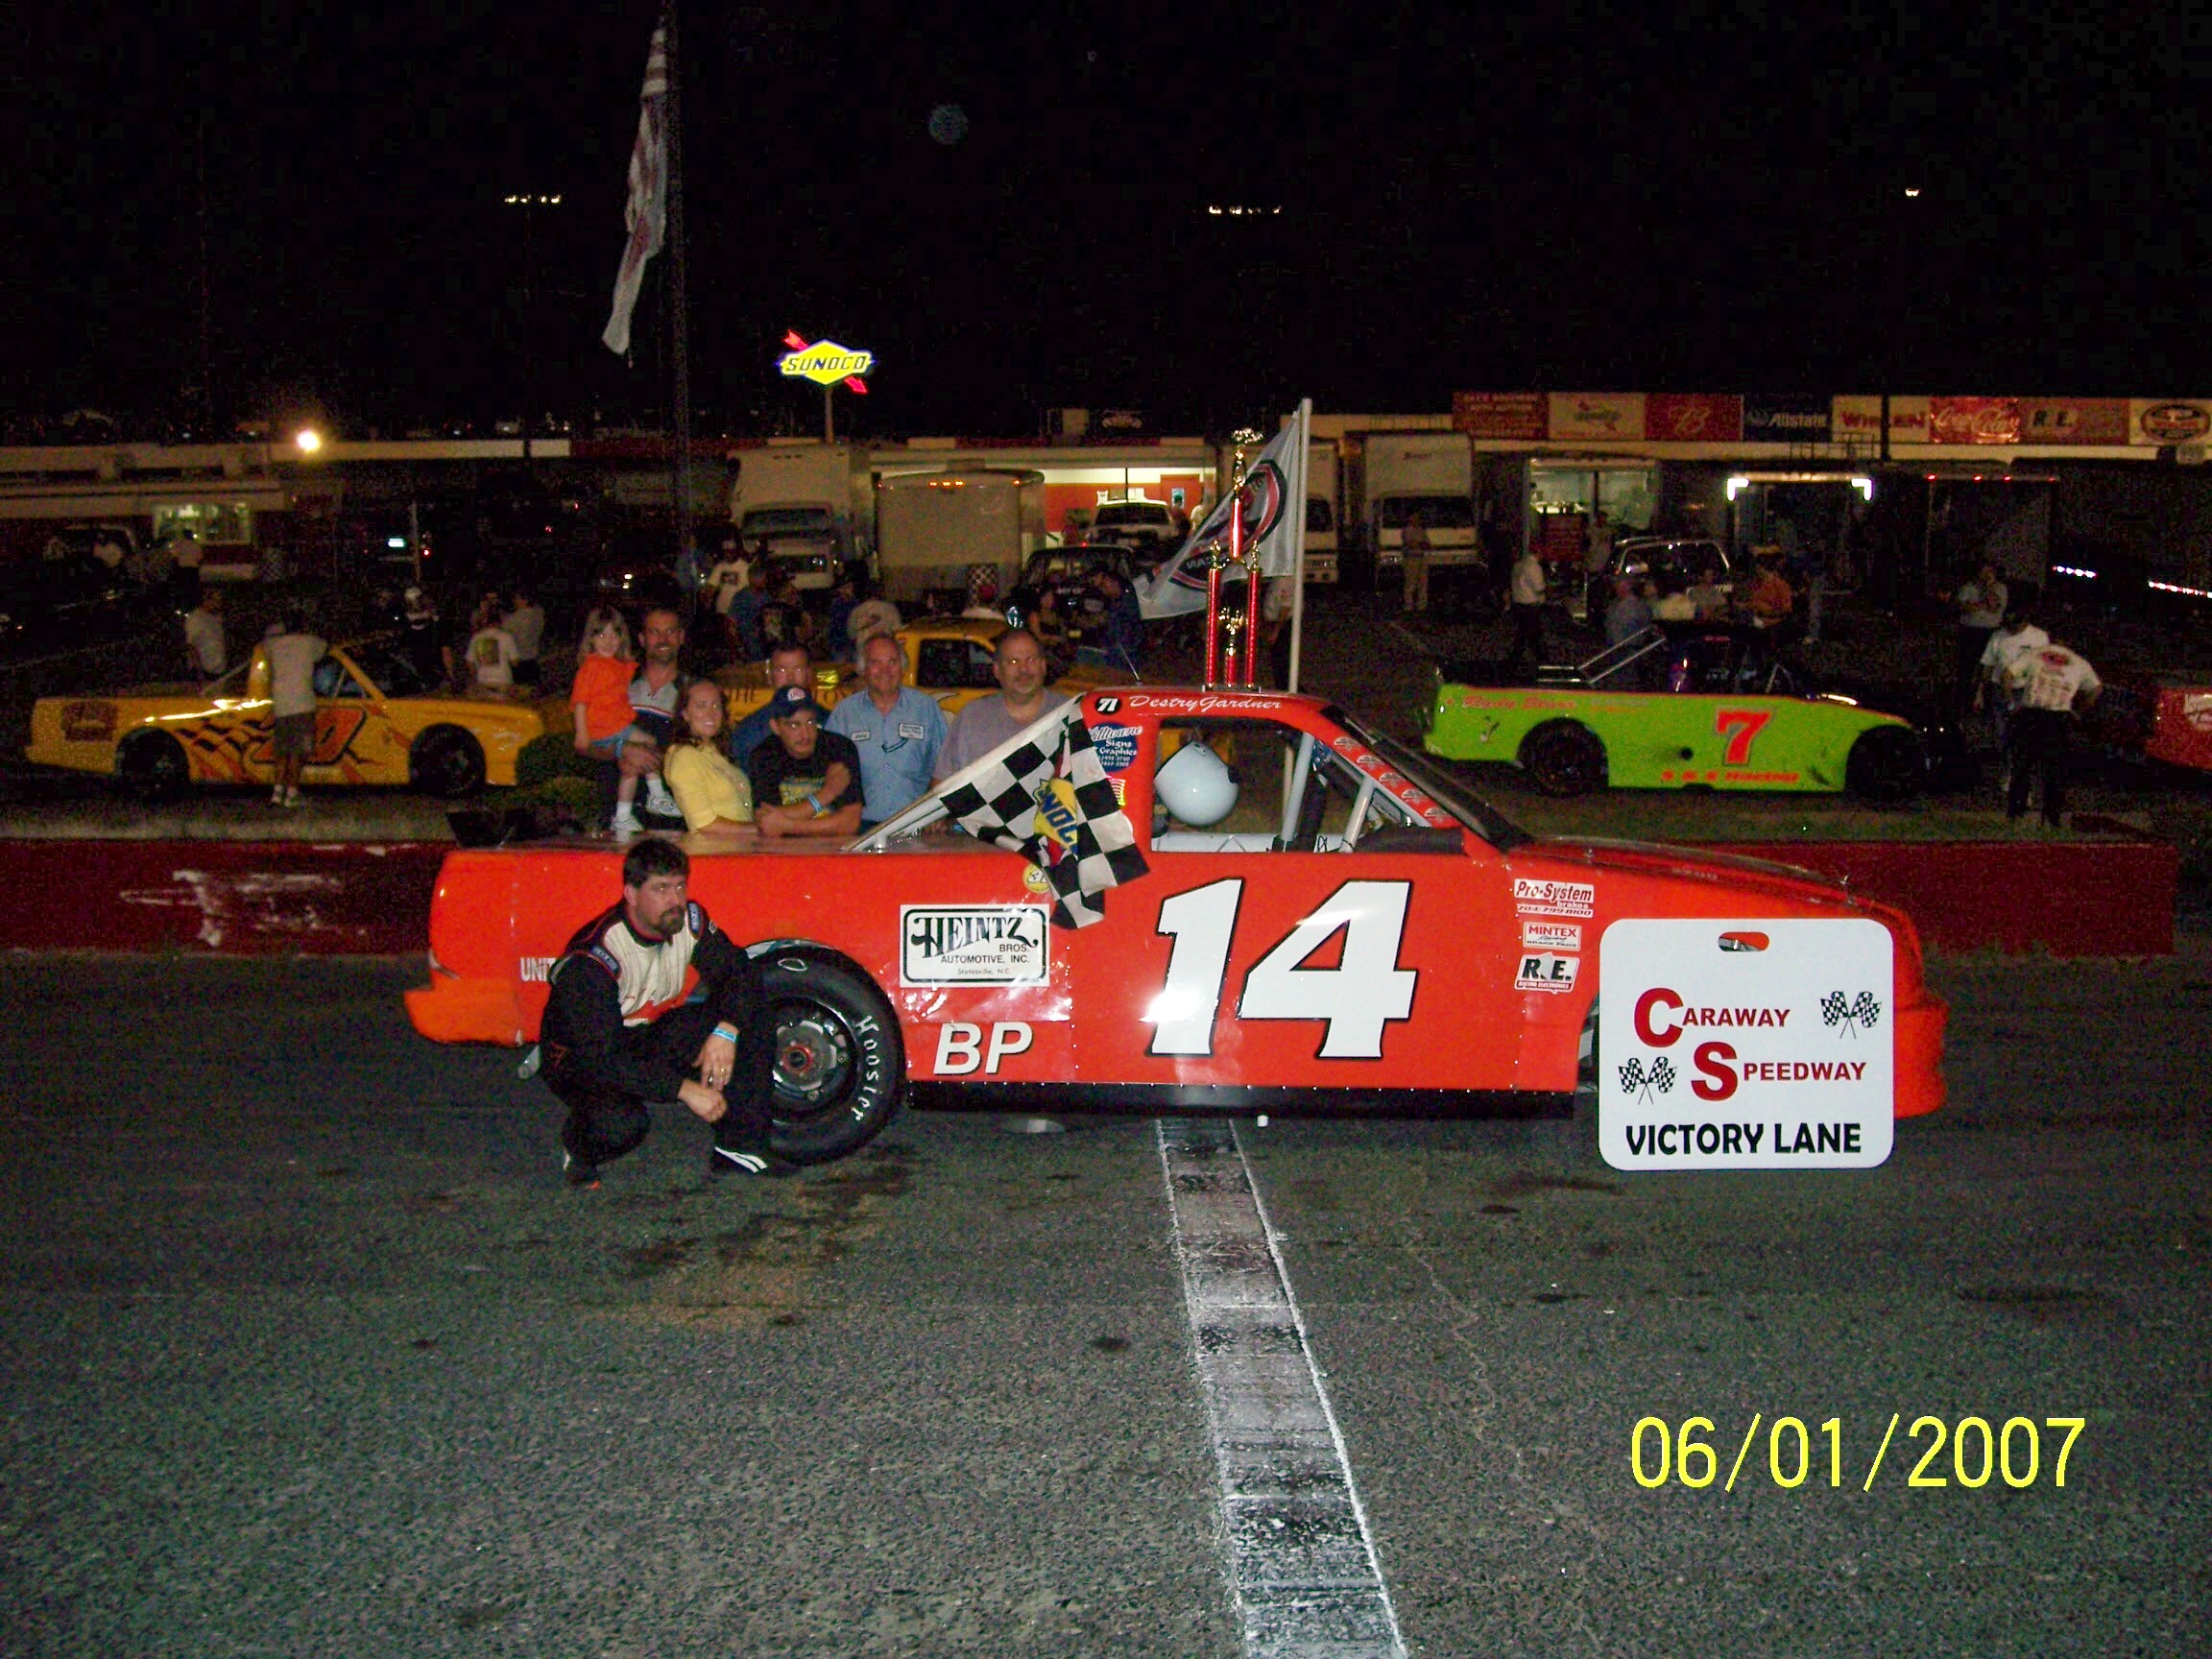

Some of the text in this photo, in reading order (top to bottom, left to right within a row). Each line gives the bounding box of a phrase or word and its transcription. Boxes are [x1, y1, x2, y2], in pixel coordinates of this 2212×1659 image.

[785, 355, 867, 372] SUNOCO
[1097, 698, 1118, 711] 71
[1129, 694, 1283, 713] Destry Gardner
[1105, 738, 1133, 750] Signs
[1716, 707, 1773, 766] 7
[1099, 747, 1138, 757] Graphics
[1517, 881, 1593, 902] Pro-System
[910, 917, 1039, 958] HEINTZ
[1528, 926, 1577, 938] MINTEX
[999, 944, 1030, 952] BROS.
[941, 954, 1030, 964] AUTOMOTIVE, INC.
[1145, 877, 1418, 1059] 14
[1633, 988, 1791, 1047] CARAWAY
[932, 1020, 1034, 1075] BP
[851, 1015, 883, 1121] Hoosier
[1691, 1042, 1867, 1101] SPEEDWAY
[1625, 1123, 1862, 1155] VICTORY LANE
